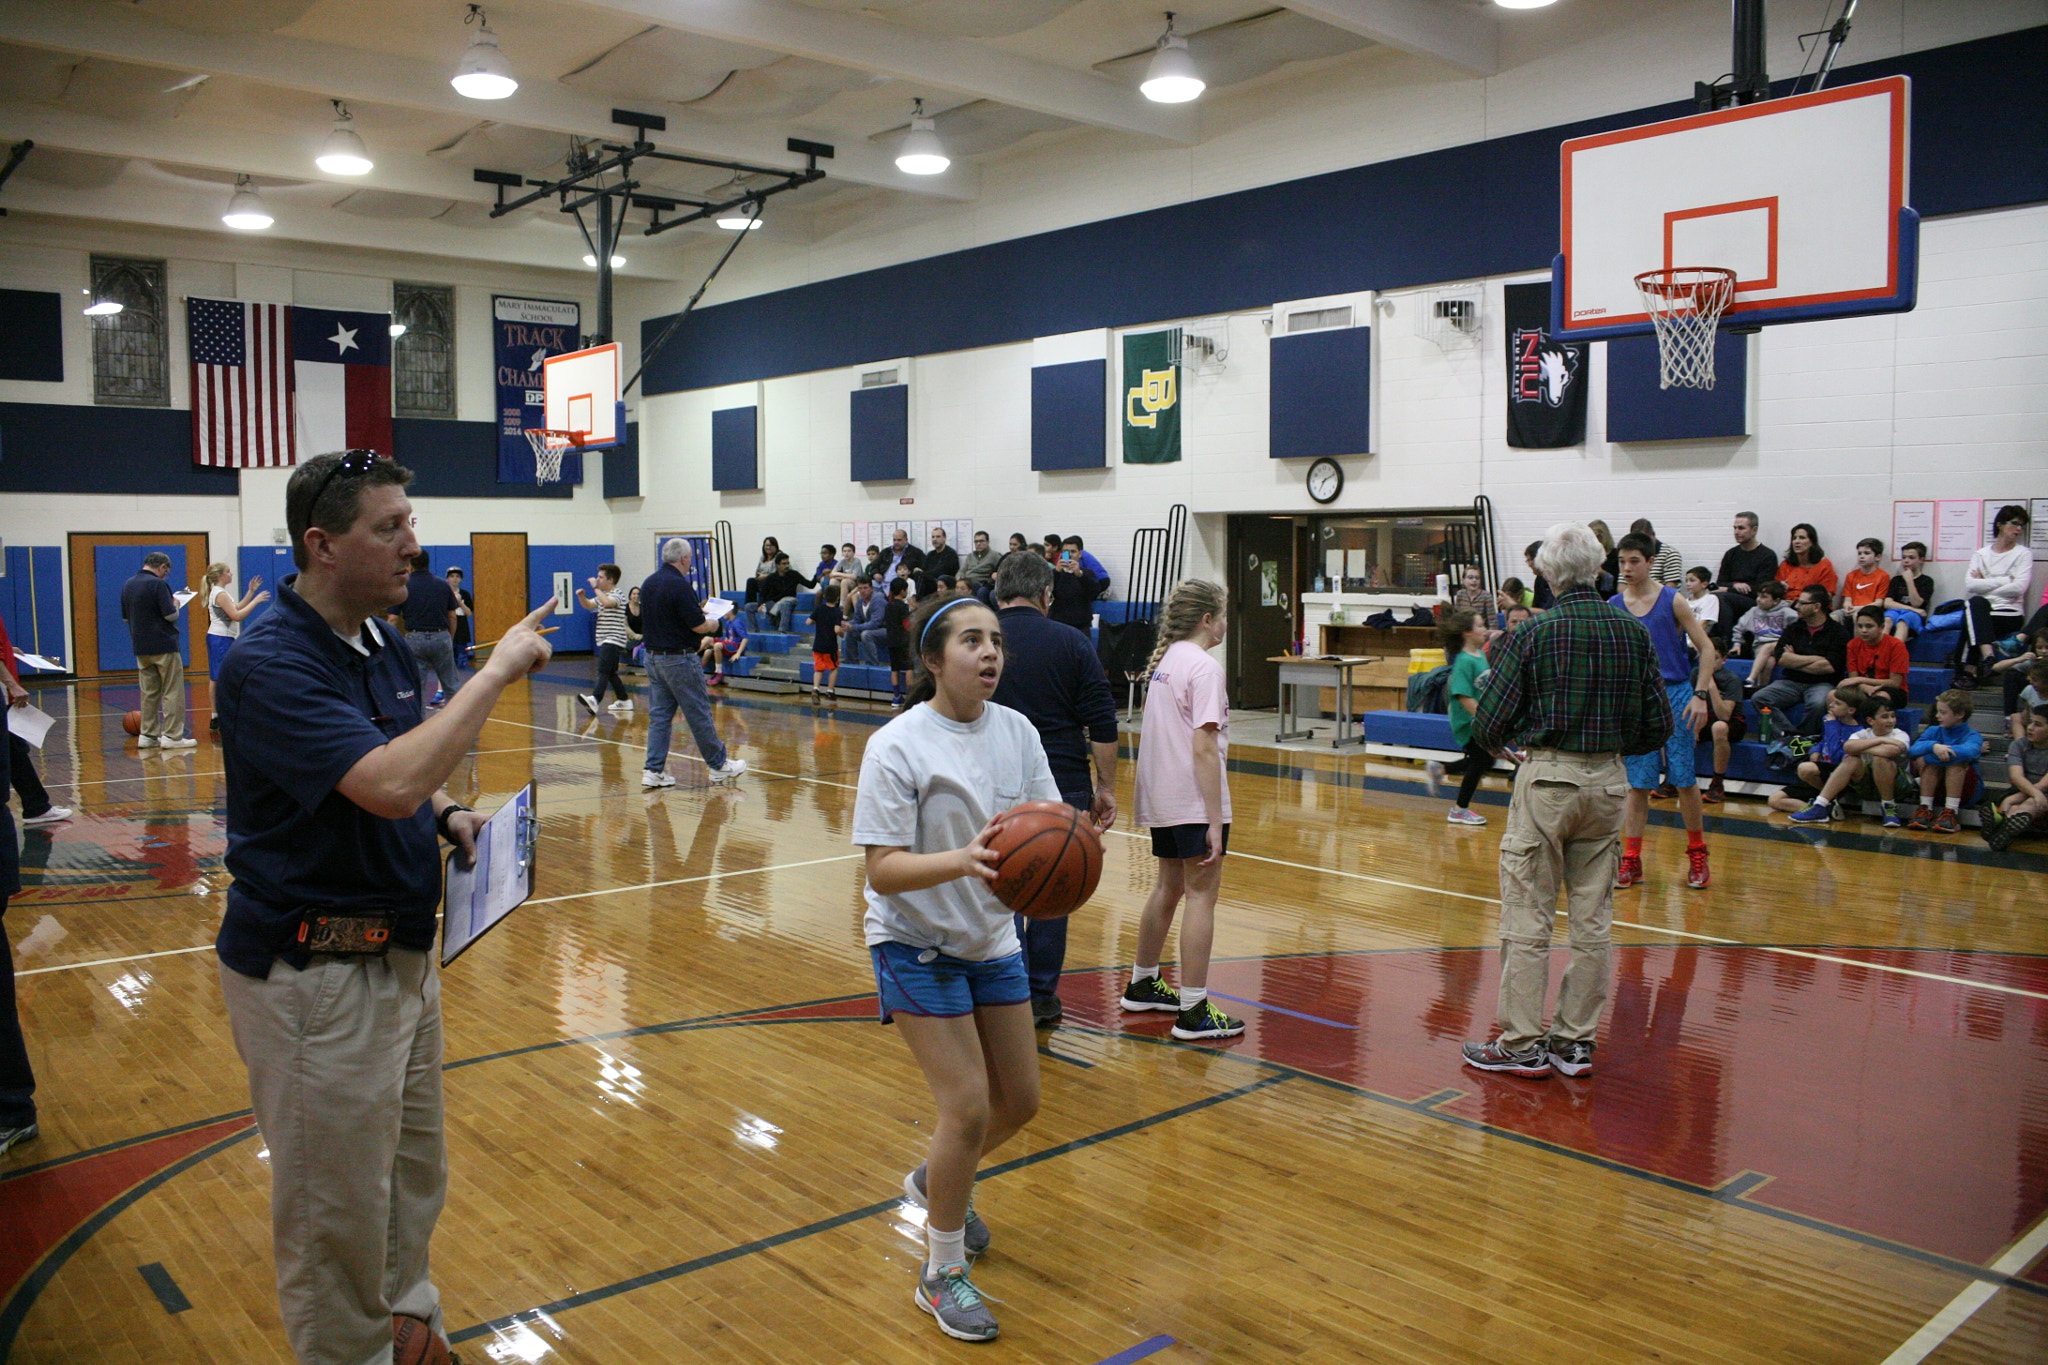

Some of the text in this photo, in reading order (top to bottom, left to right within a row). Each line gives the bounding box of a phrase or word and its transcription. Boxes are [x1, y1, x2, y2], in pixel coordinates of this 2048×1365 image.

[498, 301, 575, 314] MARY IMMACULATE
[520, 312, 553, 322] SCHOOL
[504, 323, 566, 352] TRACK
[1521, 333, 1540, 397] NIU
[525, 392, 545, 403] DP
[1127, 365, 1177, 429] BU
